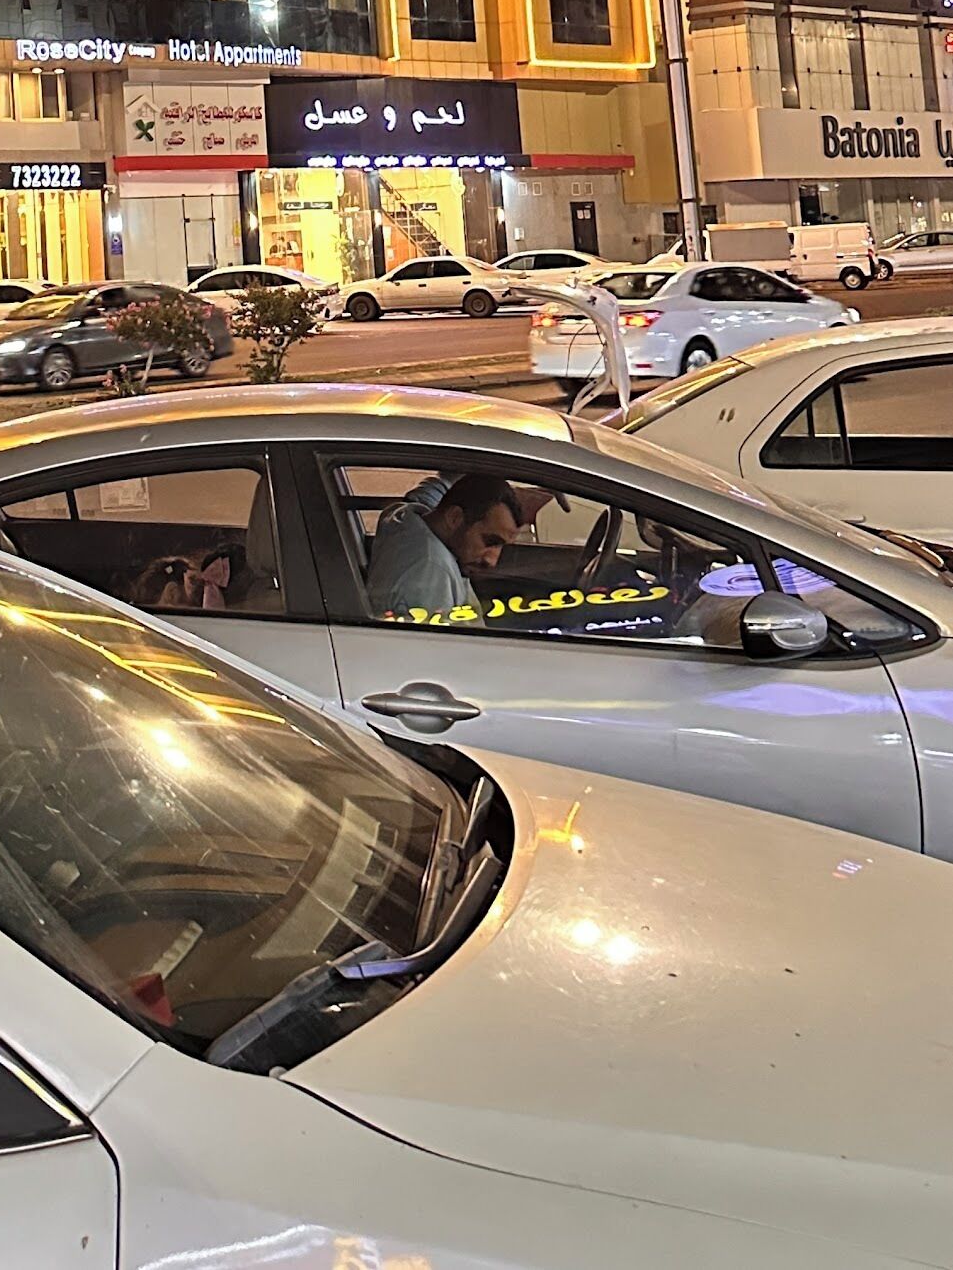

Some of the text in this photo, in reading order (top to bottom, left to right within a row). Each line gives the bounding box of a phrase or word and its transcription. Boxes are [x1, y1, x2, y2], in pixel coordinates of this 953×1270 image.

[168, 38, 210, 62] Hotel
[304, 99, 466, 133] لحم و عسل
[820, 115, 921, 158] Batonia
[11, 165, 81, 188] 7323222
